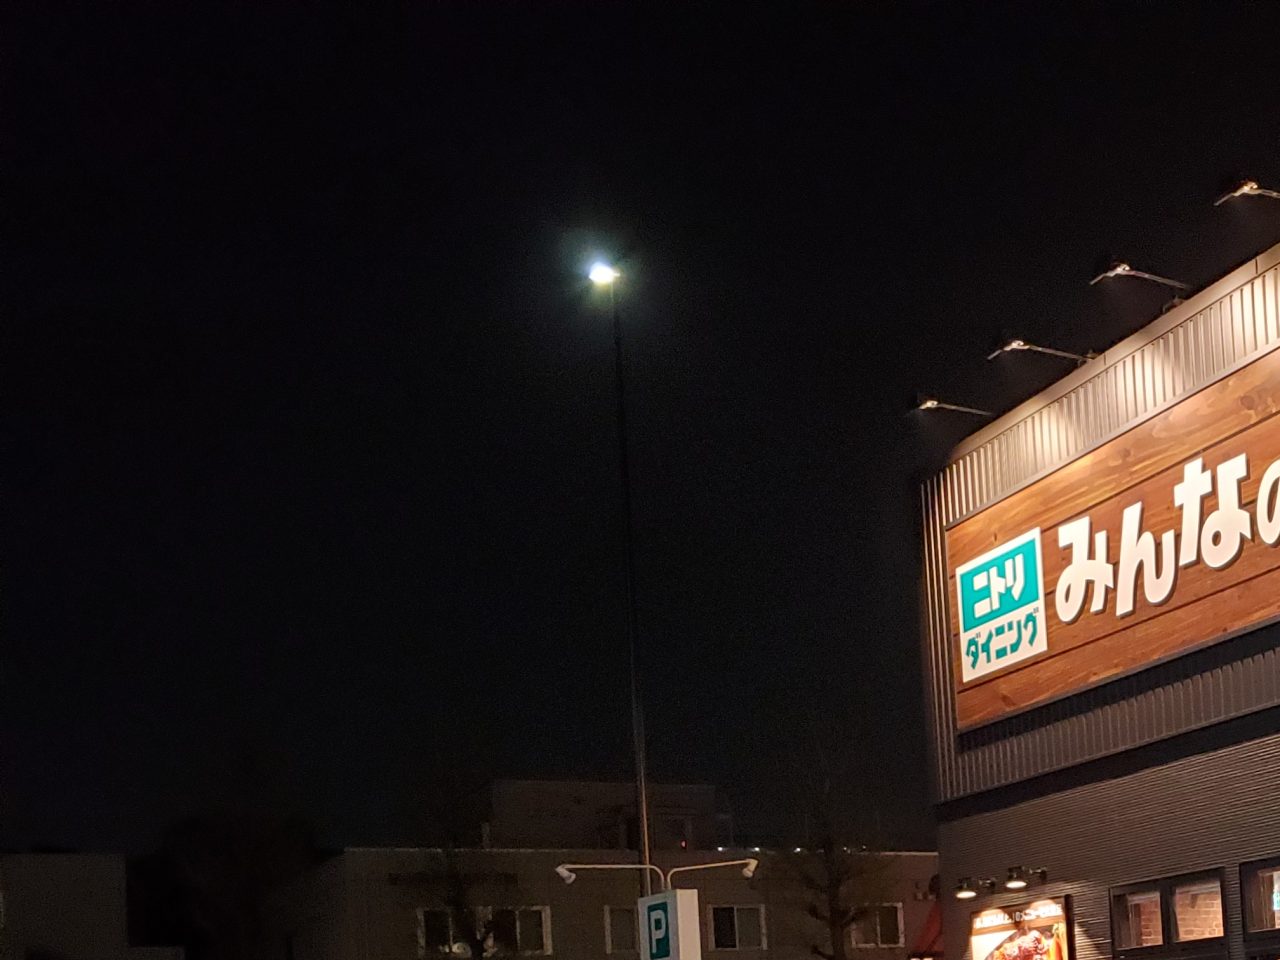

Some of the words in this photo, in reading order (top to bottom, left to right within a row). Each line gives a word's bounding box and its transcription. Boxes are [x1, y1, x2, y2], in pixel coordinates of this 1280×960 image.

[973, 553, 1025, 618] ニトリ
[966, 607, 1039, 670] ダイニング
[650, 909, 666, 954] P
